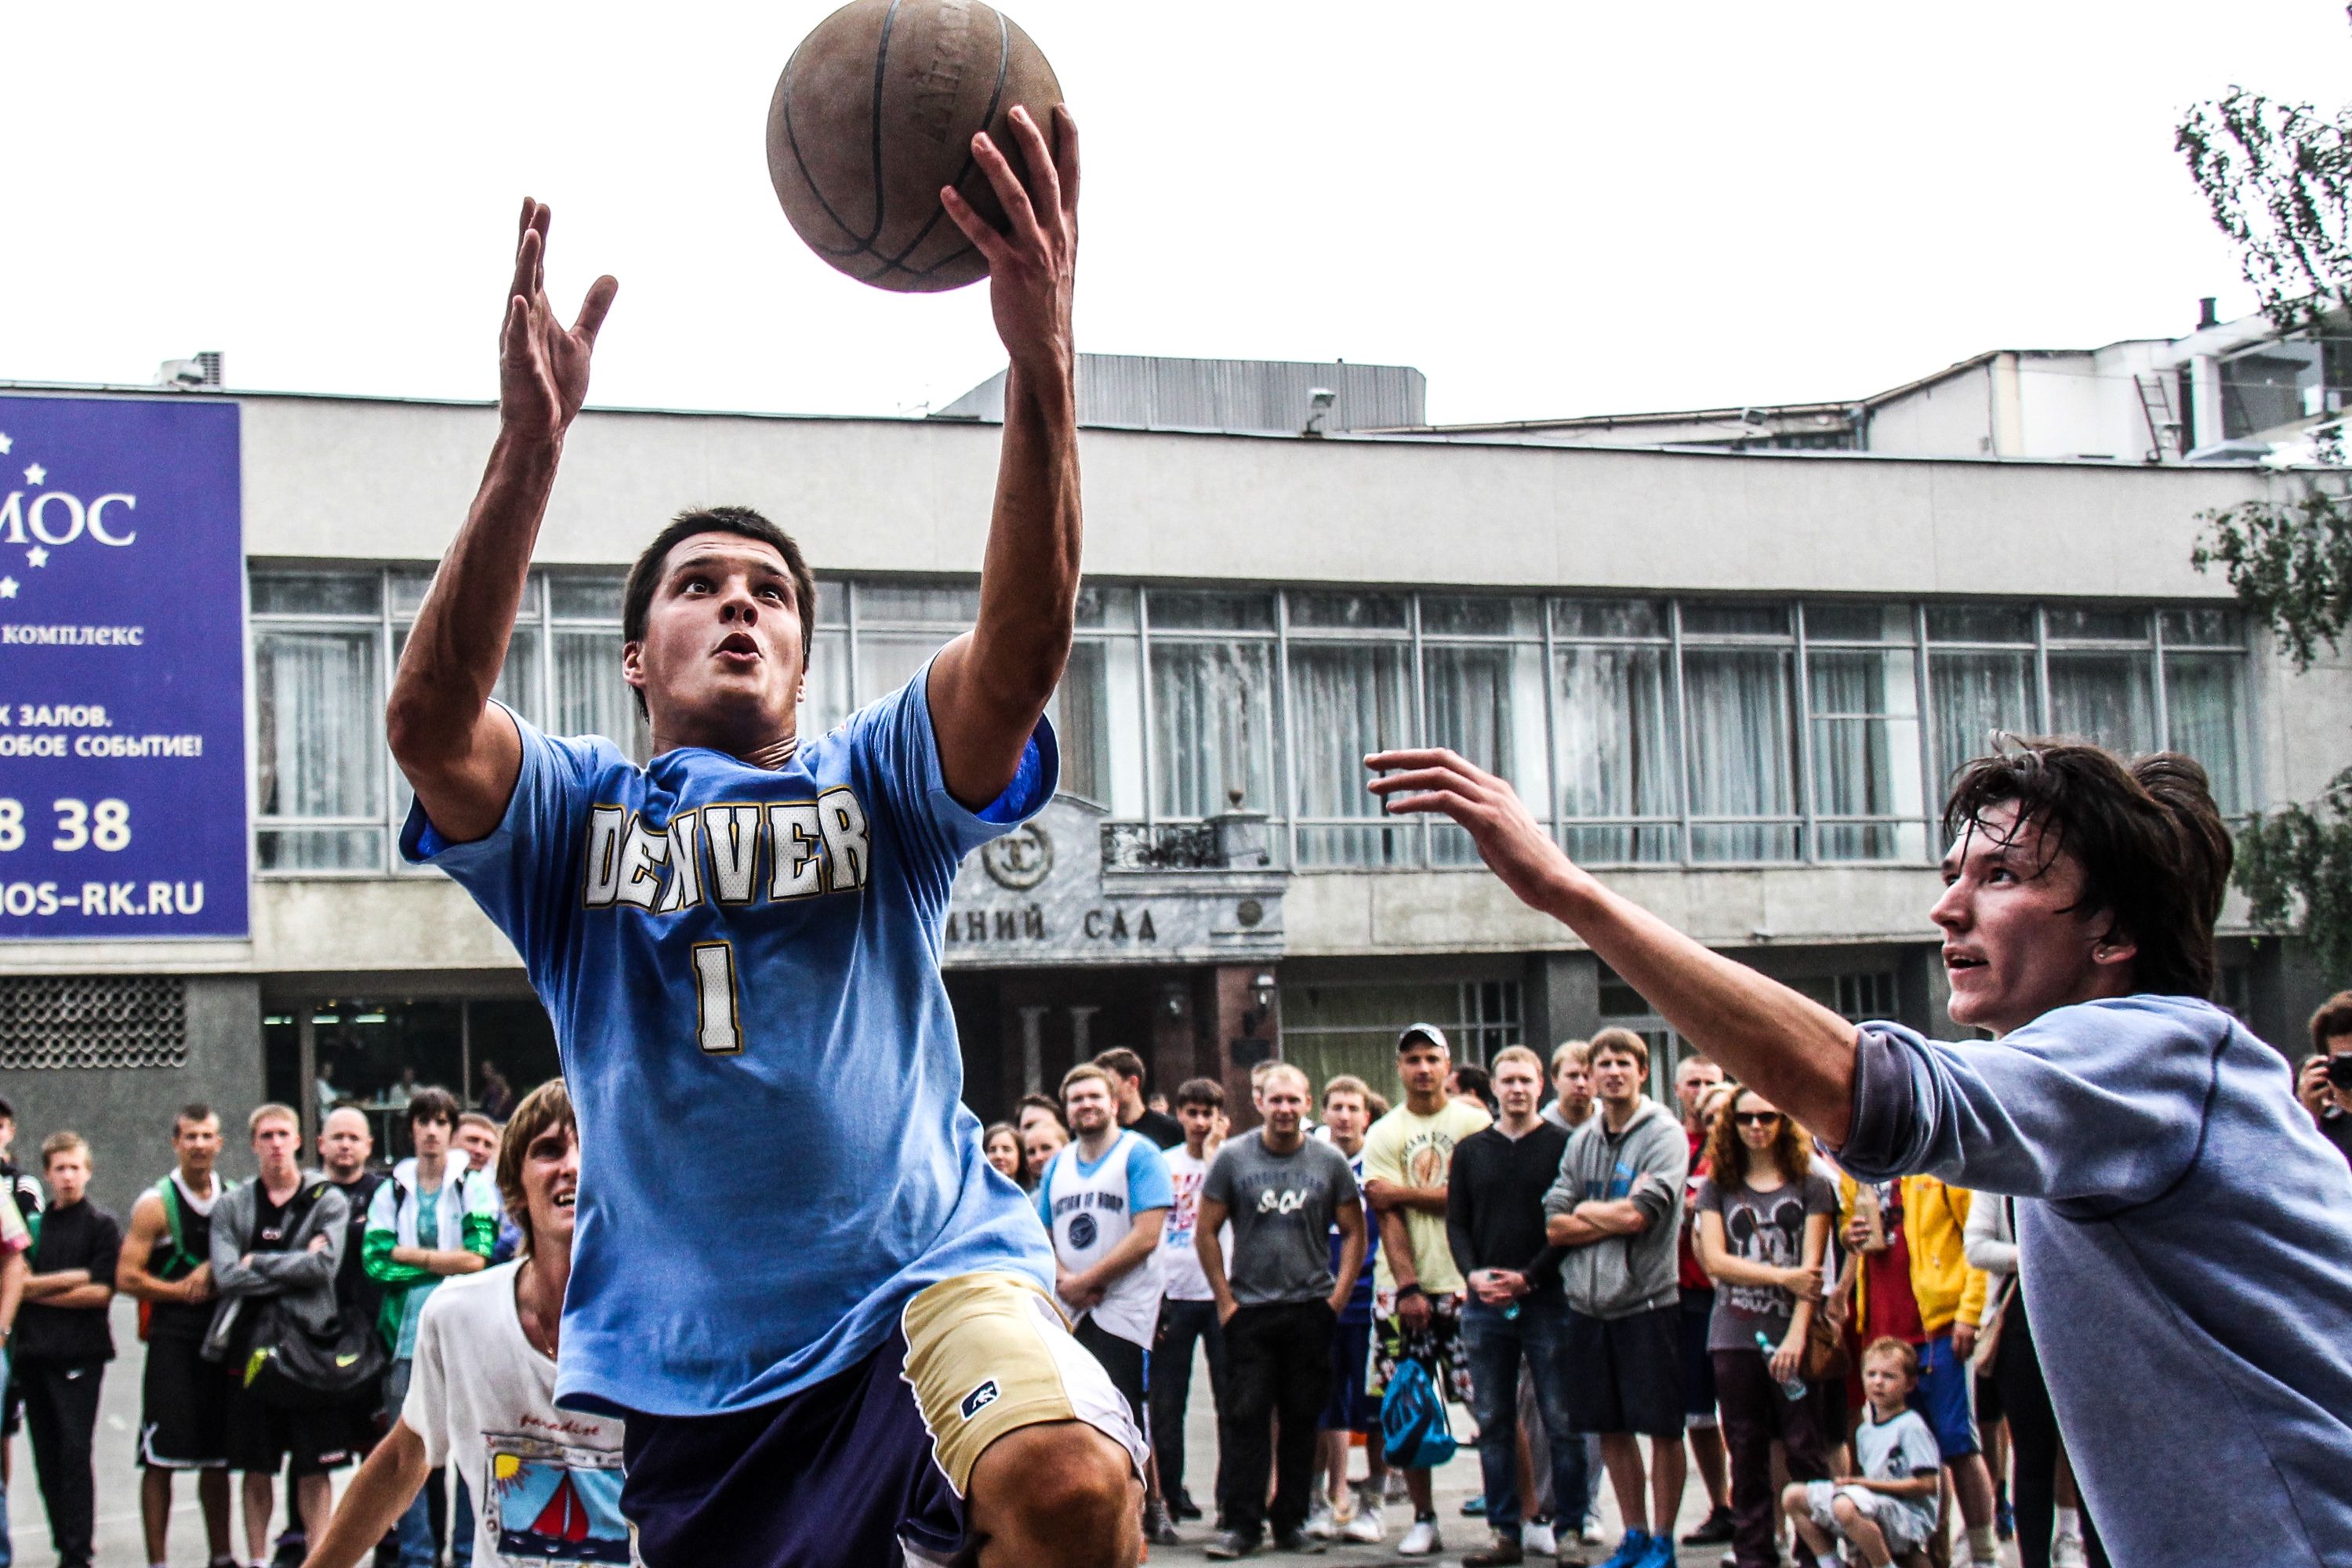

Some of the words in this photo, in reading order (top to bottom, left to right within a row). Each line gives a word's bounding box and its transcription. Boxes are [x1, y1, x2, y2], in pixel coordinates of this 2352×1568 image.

[2, 625, 144, 646] комплекс
[19, 704, 113, 728] ЗАЛОВ.
[74, 735, 203, 757] СОБЫТИЕ!
[53, 798, 132, 851] 38
[582, 784, 870, 916] DENVER
[0, 881, 204, 916] OS-RK.RU
[691, 938, 743, 1055] 1
